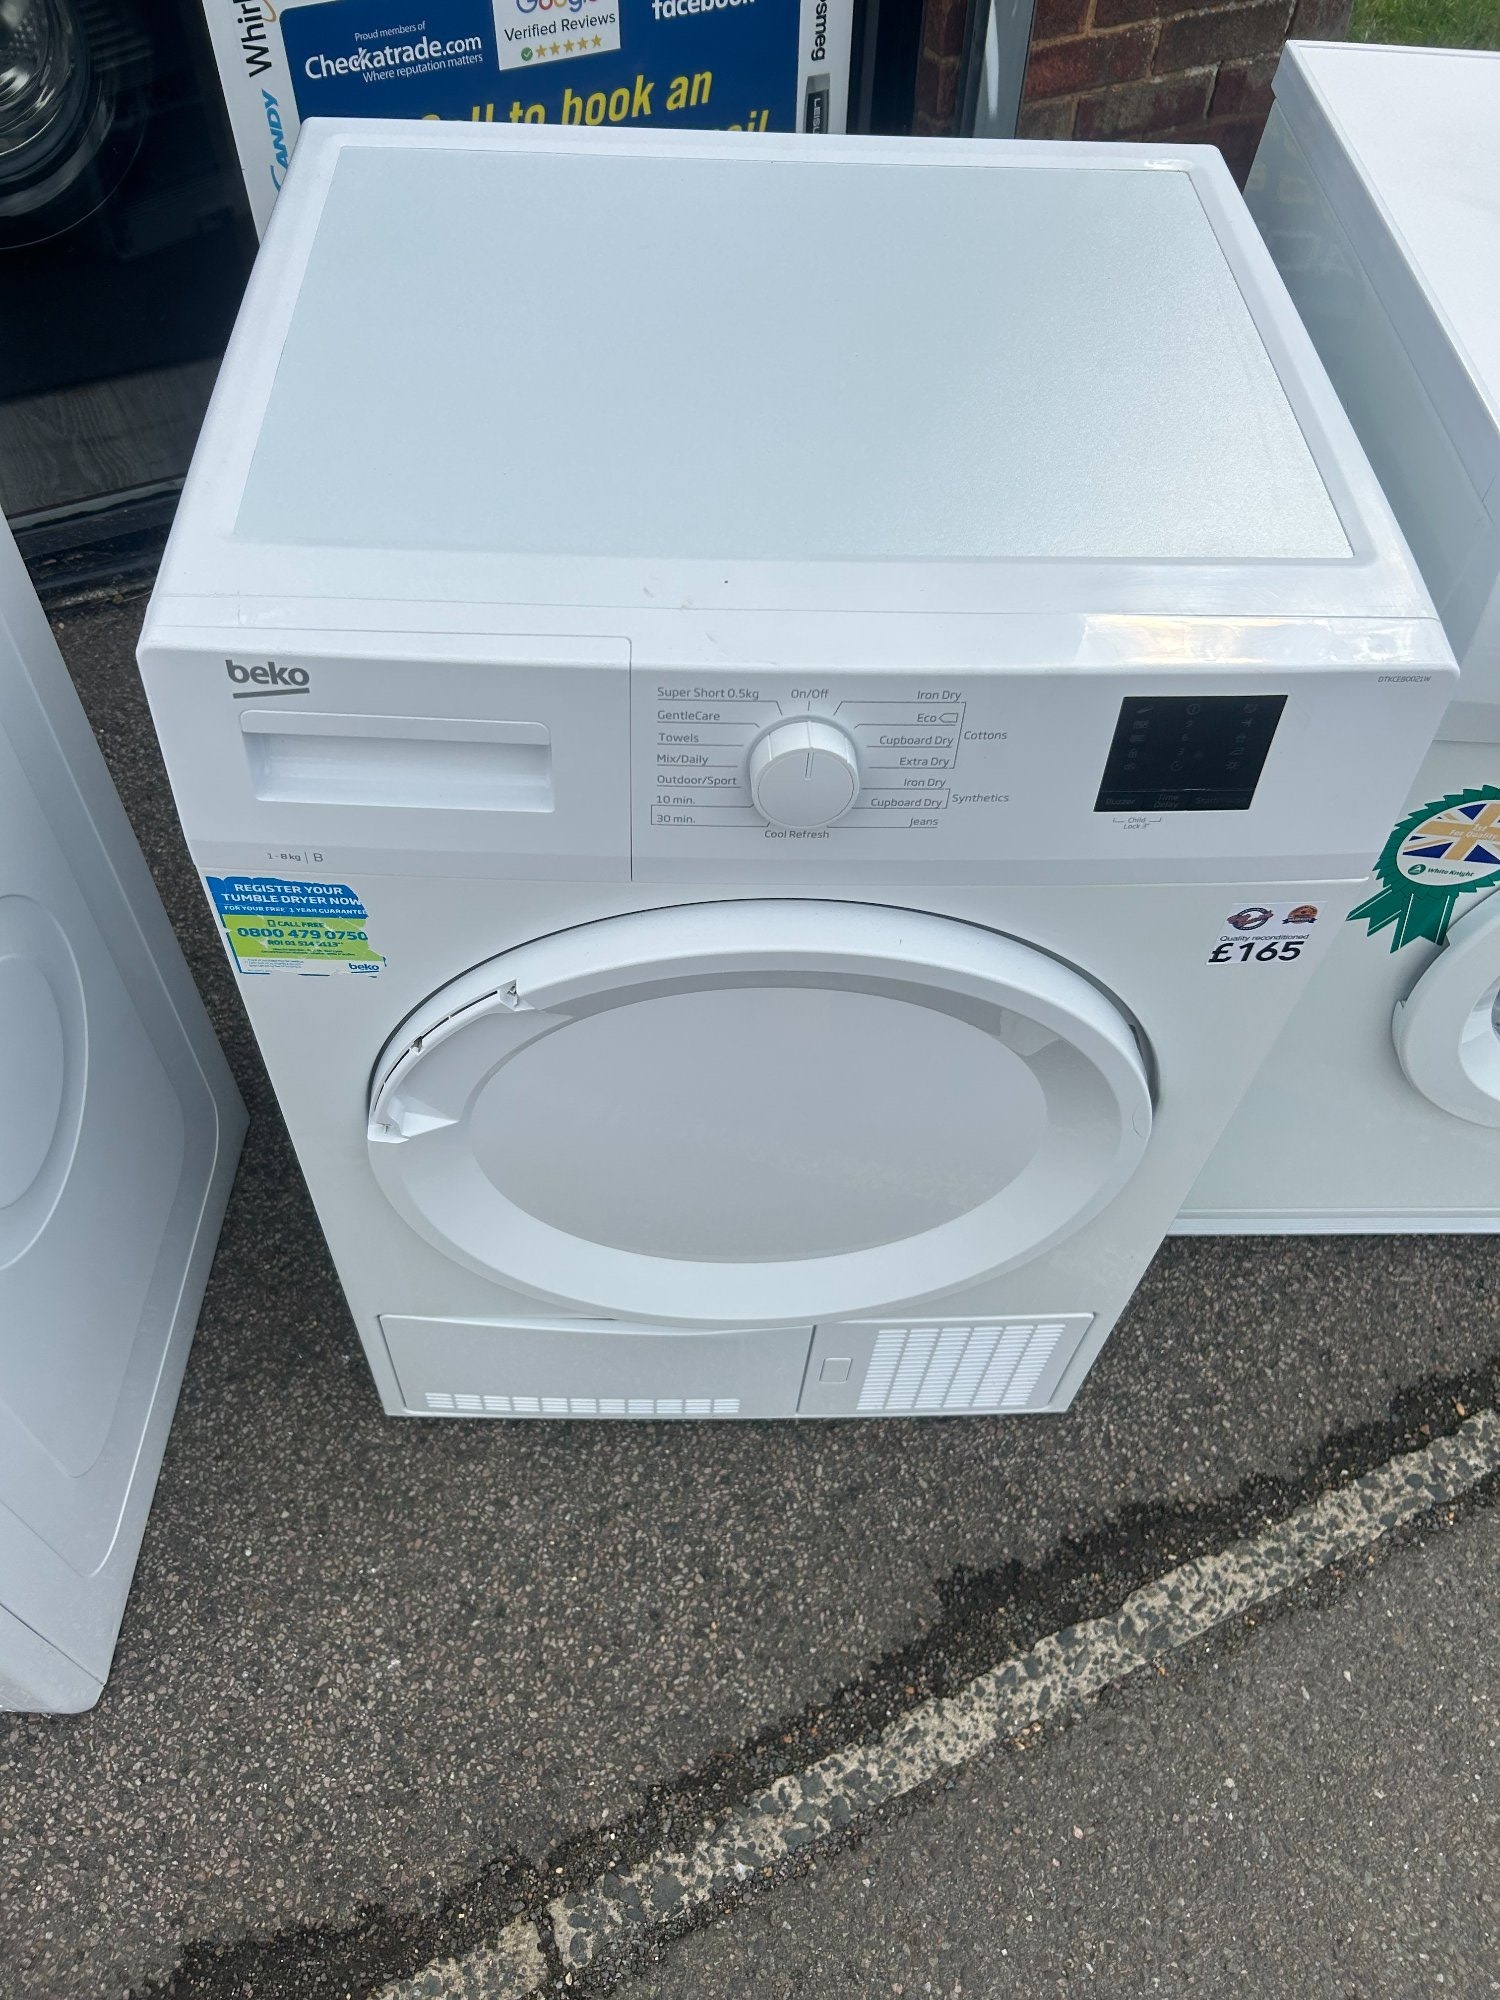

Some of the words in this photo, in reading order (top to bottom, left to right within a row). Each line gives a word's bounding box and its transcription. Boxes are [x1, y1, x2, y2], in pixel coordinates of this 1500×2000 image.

[651, 0, 755, 20] facebo
[355, 29, 378, 42] Proud
[380, 24, 416, 37] members
[417, 20, 426, 31] of
[504, 22, 557, 41] Verified
[562, 13, 616, 32] Reviews
[811, 2, 827, 61] smeg
[305, 36, 482, 79] Checkatrade.com
[362, 68, 395, 83] Where
[397, 60, 446, 78] reputation
[447, 54, 483, 67] matters
[562, 75, 654, 126] book
[666, 71, 713, 111] an
[225, 659, 310, 687] beko
[657, 687, 691, 699] Super
[694, 688, 725, 698] Short
[727, 688, 759, 700] 0.5kg
[791, 689, 829, 699] On/Off
[917, 690, 939, 700] Iron
[942, 690, 962, 702] Dry
[657, 710, 720, 721] GentleCare
[917, 713, 937, 723] Eco
[659, 733, 699, 743] Towels
[964, 731, 1008, 740] Cottons
[880, 736, 932, 746] Cupboard
[935, 736, 954, 747] Dry
[657, 754, 709, 766] Mix/Daily
[900, 757, 928, 766] Extra
[931, 757, 950, 768] Dry
[657, 775, 736, 786] Outdoor/Sport
[904, 778, 925, 787] Iron
[927, 778, 946, 789] Dry
[657, 795, 670, 804] 10
[673, 796, 695, 805] min.
[871, 798, 921, 808] Cupboard
[924, 799, 943, 809] Dry
[952, 794, 1009, 804] Synthetics
[657, 815, 671, 823] 30
[673, 815, 696, 823] min.
[910, 818, 939, 828] Jeans
[764, 830, 787, 839] Cool
[789, 830, 830, 839] Refresh
[1427, 867, 1449, 876] White
[1449, 869, 1475, 878] Knight
[234, 884, 302, 895] REGISTER
[304, 886, 343, 895] YOUR
[220, 894, 279, 903] TUMBLE
[280, 895, 327, 904] DRYER
[329, 897, 362, 906] NOW
[277, 920, 300, 928] CALL
[237, 927, 284, 938] 0800
[287, 929, 322, 939] 479
[324, 930, 369, 941] 0750
[1251, 933, 1310, 942] reconditioned
[1208, 941, 1305, 963] £165
[348, 963, 380, 971] beko
